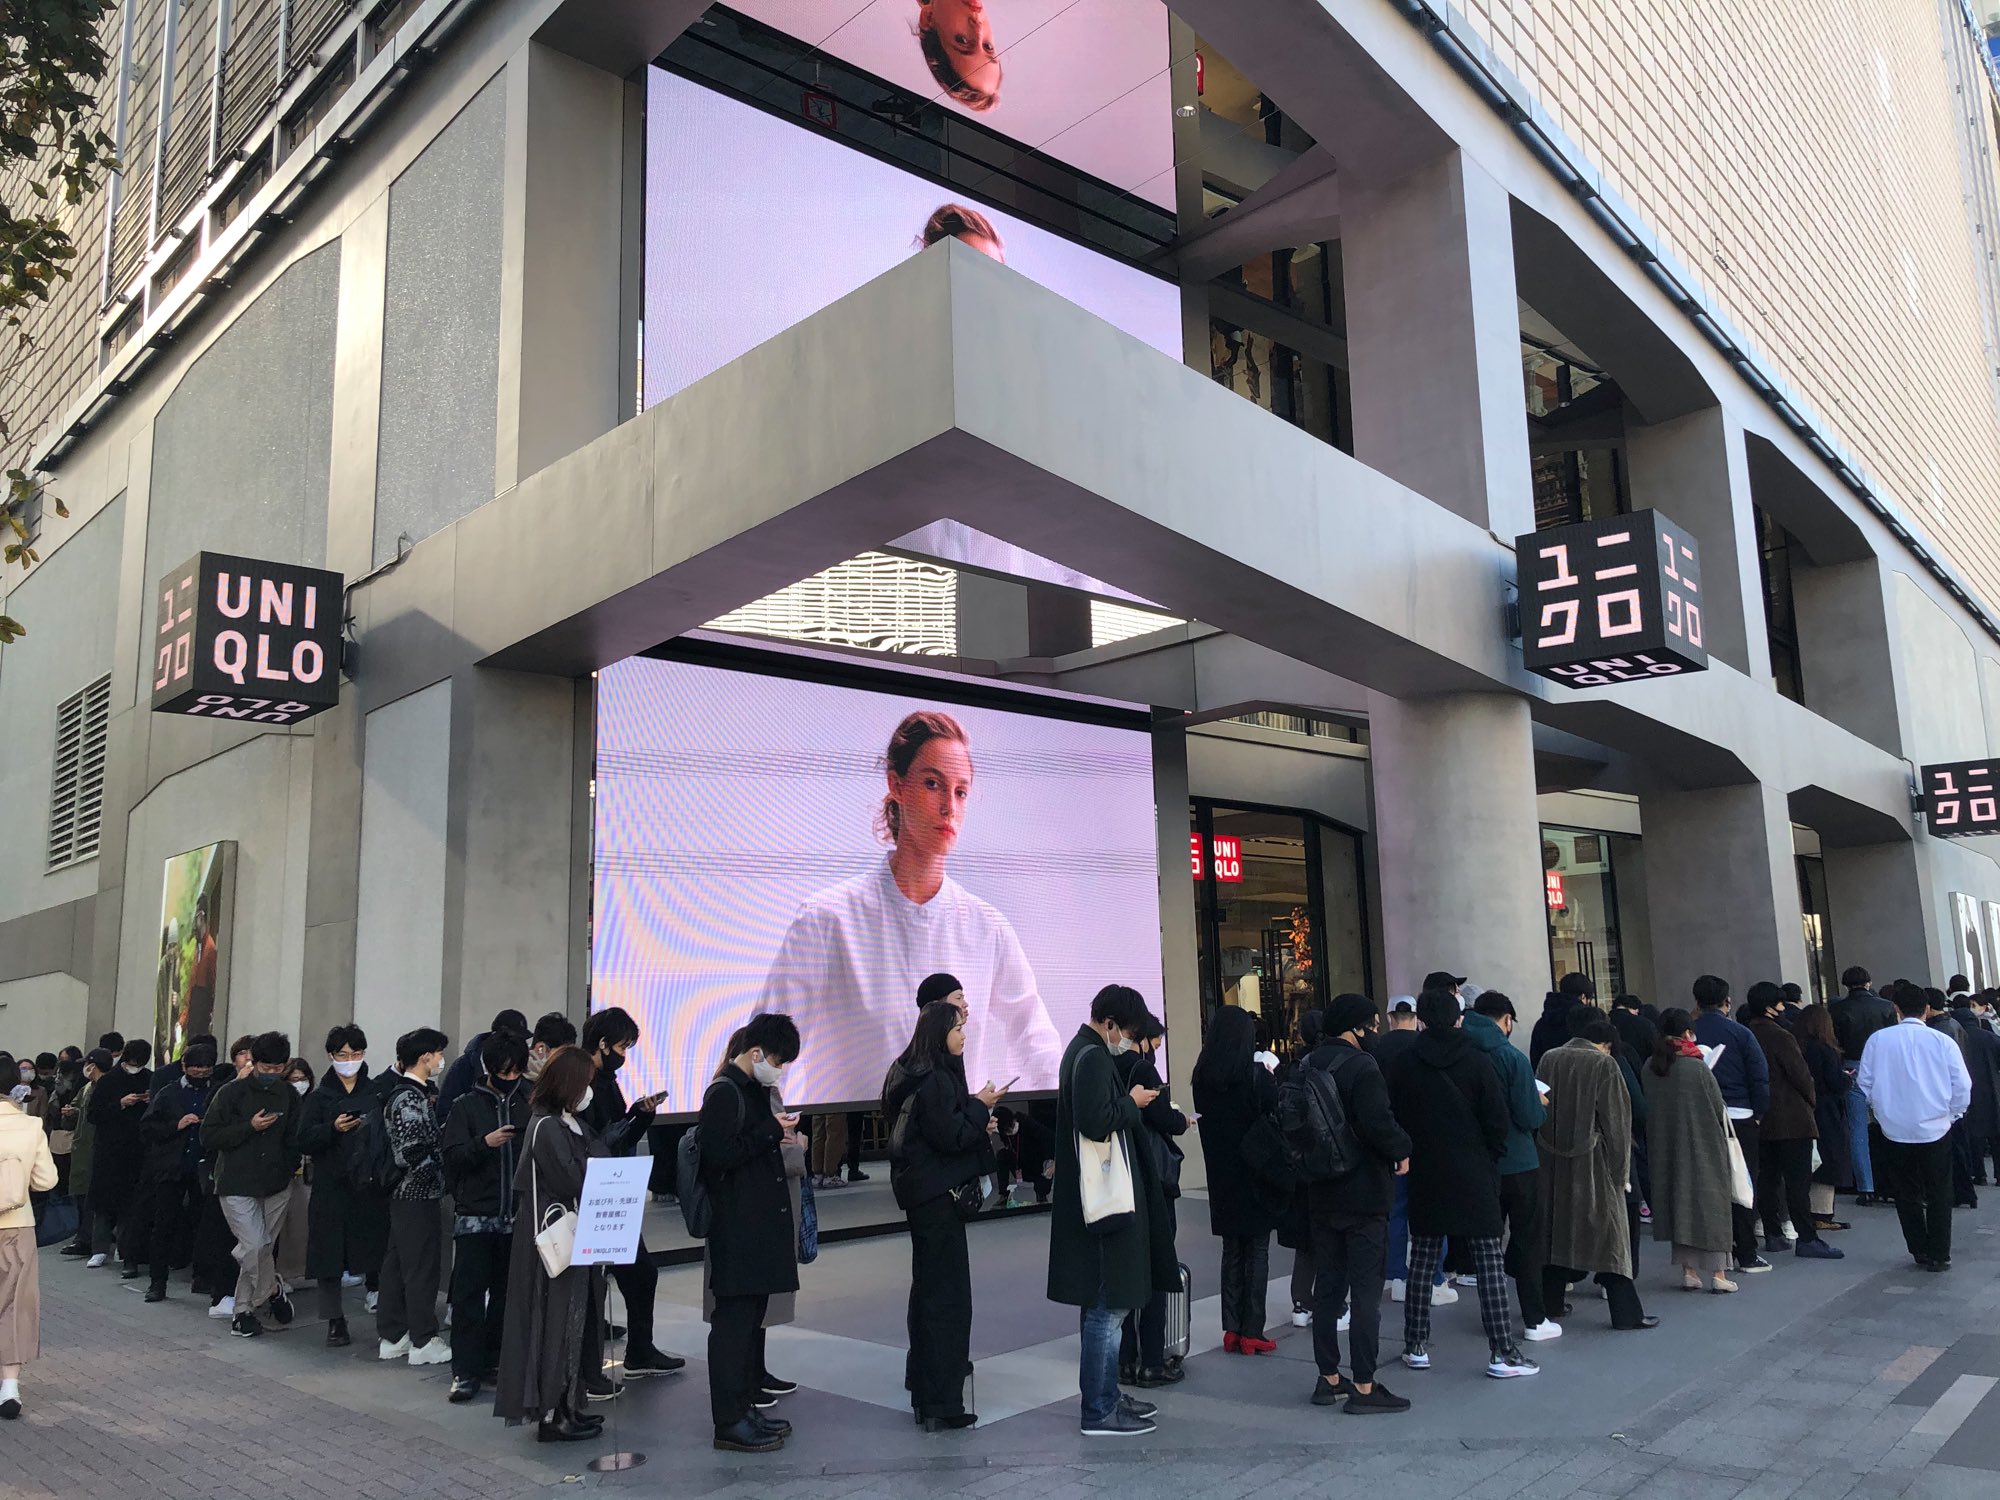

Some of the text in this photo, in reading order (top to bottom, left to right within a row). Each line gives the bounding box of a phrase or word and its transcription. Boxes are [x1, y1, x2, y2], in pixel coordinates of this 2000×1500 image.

[1537, 531, 1637, 591] ユニ
[1662, 533, 1697, 593] ユニ
[160, 575, 193, 634] ユニ
[216, 572, 317, 629] UNI
[1537, 588, 1643, 648] クロ
[1667, 590, 1703, 648] クロ
[155, 631, 191, 691] クロ
[213, 629, 324, 685] QLO
[1549, 654, 1657, 676] UNI
[1573, 663, 1683, 686] QLO
[186, 704, 292, 722] UNI
[196, 694, 311, 713] QLO
[1934, 768, 1993, 796] ユニ
[1935, 797, 1997, 825] クロ
[1213, 840, 1236, 858] UNI
[1214, 859, 1240, 879] QLO
